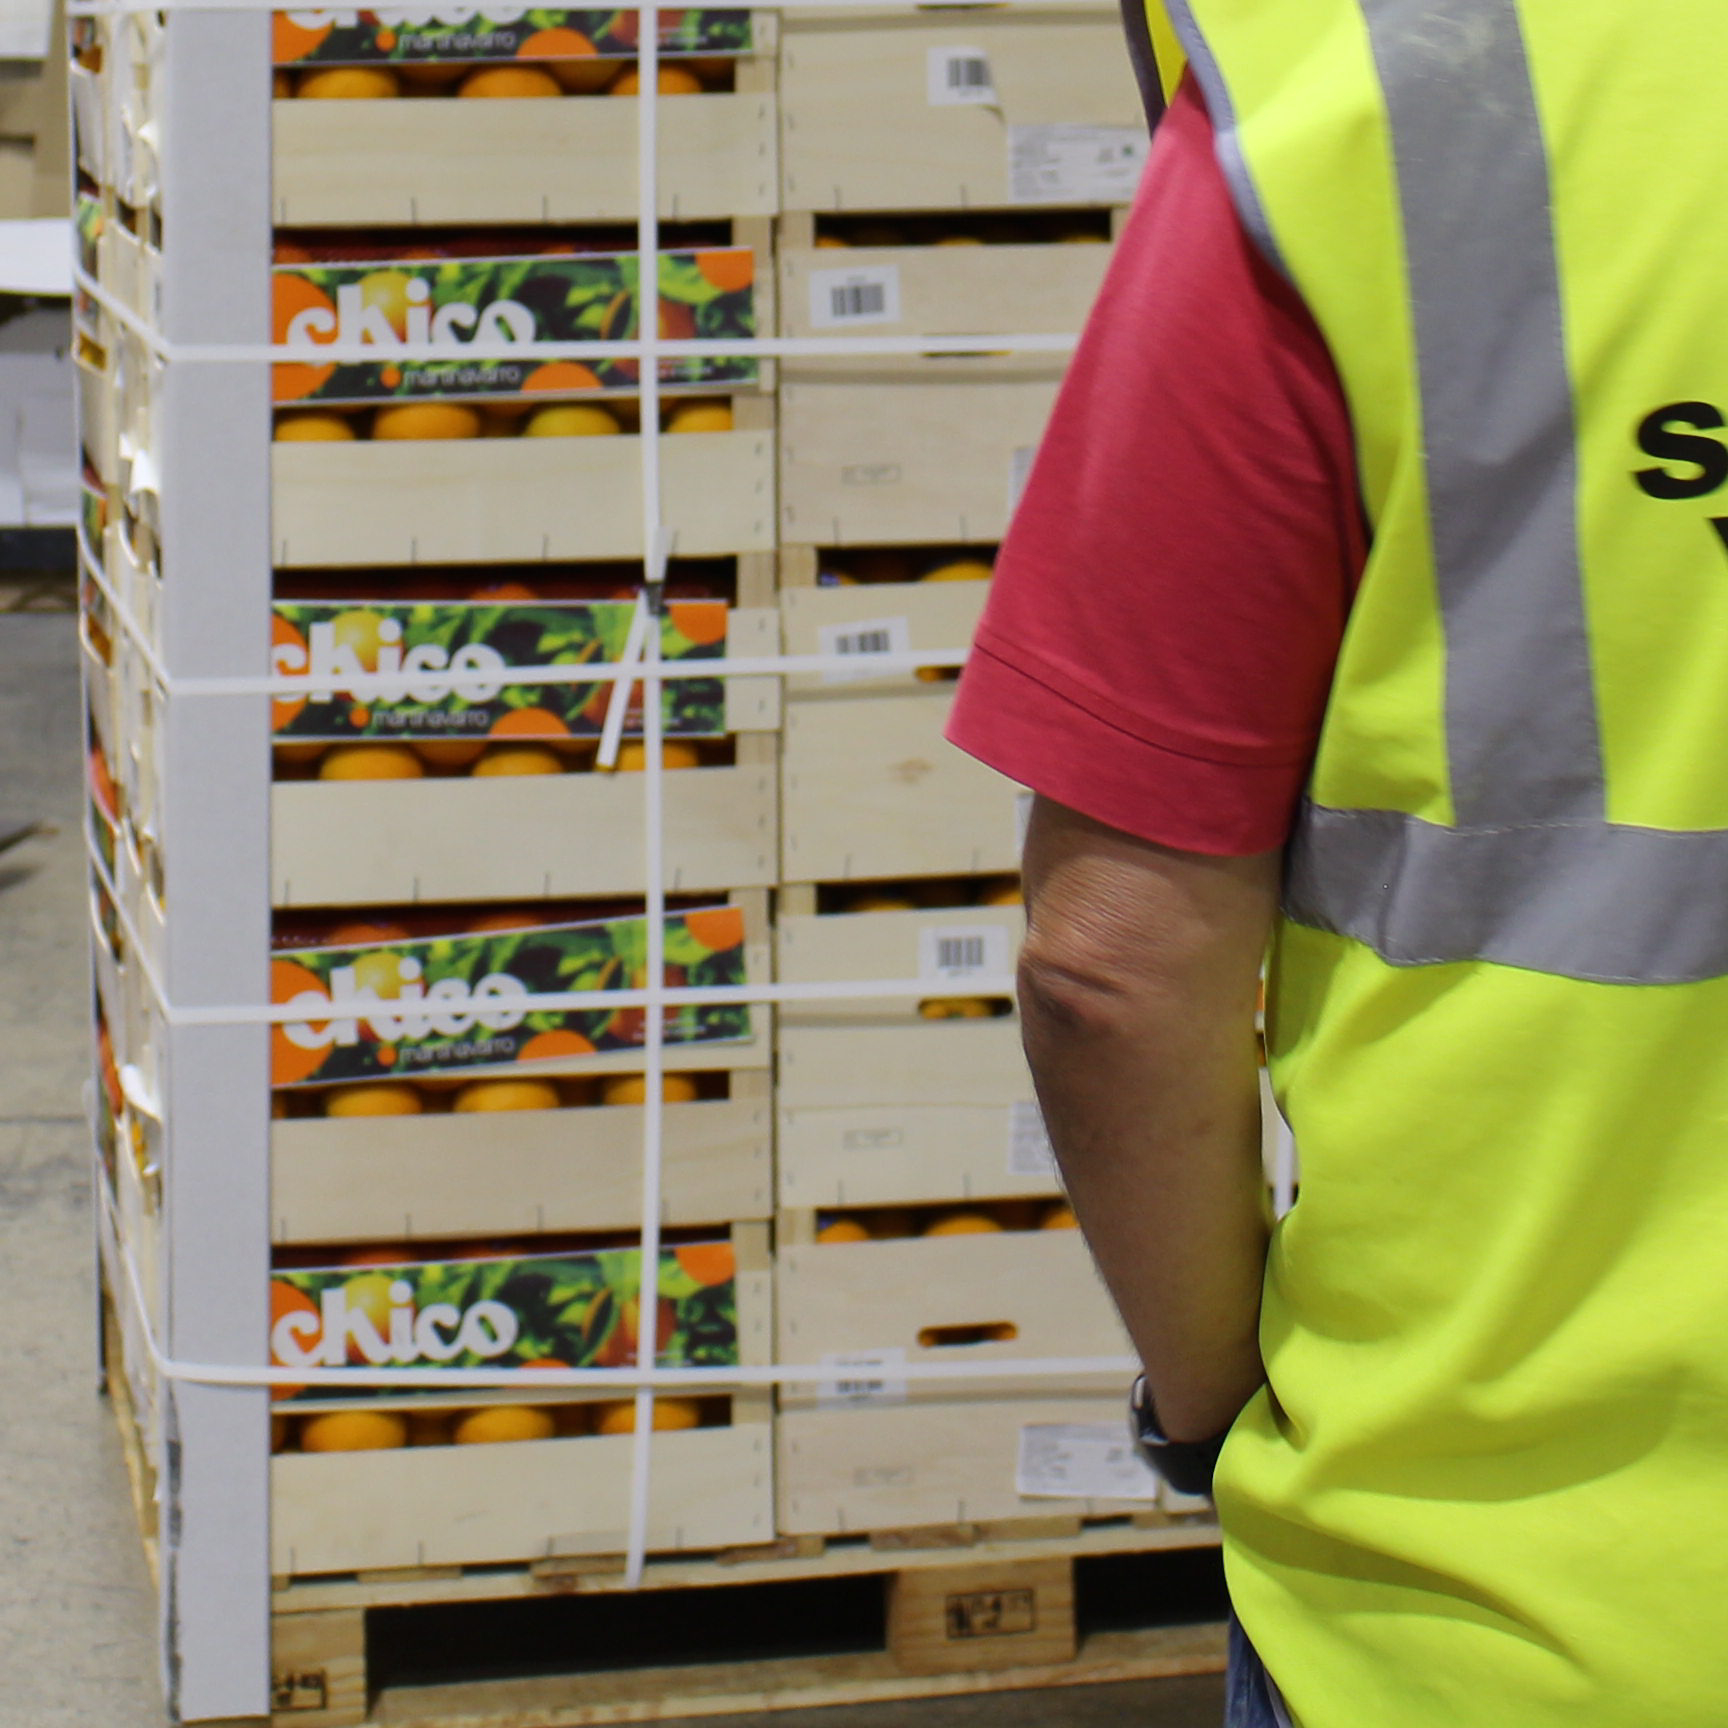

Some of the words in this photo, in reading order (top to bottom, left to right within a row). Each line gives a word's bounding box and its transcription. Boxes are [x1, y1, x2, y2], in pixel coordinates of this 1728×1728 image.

[285, 276, 536, 367] chico
[272, 617, 507, 704] chico
[282, 955, 529, 1050] chico
[273, 1279, 519, 1368] chico
